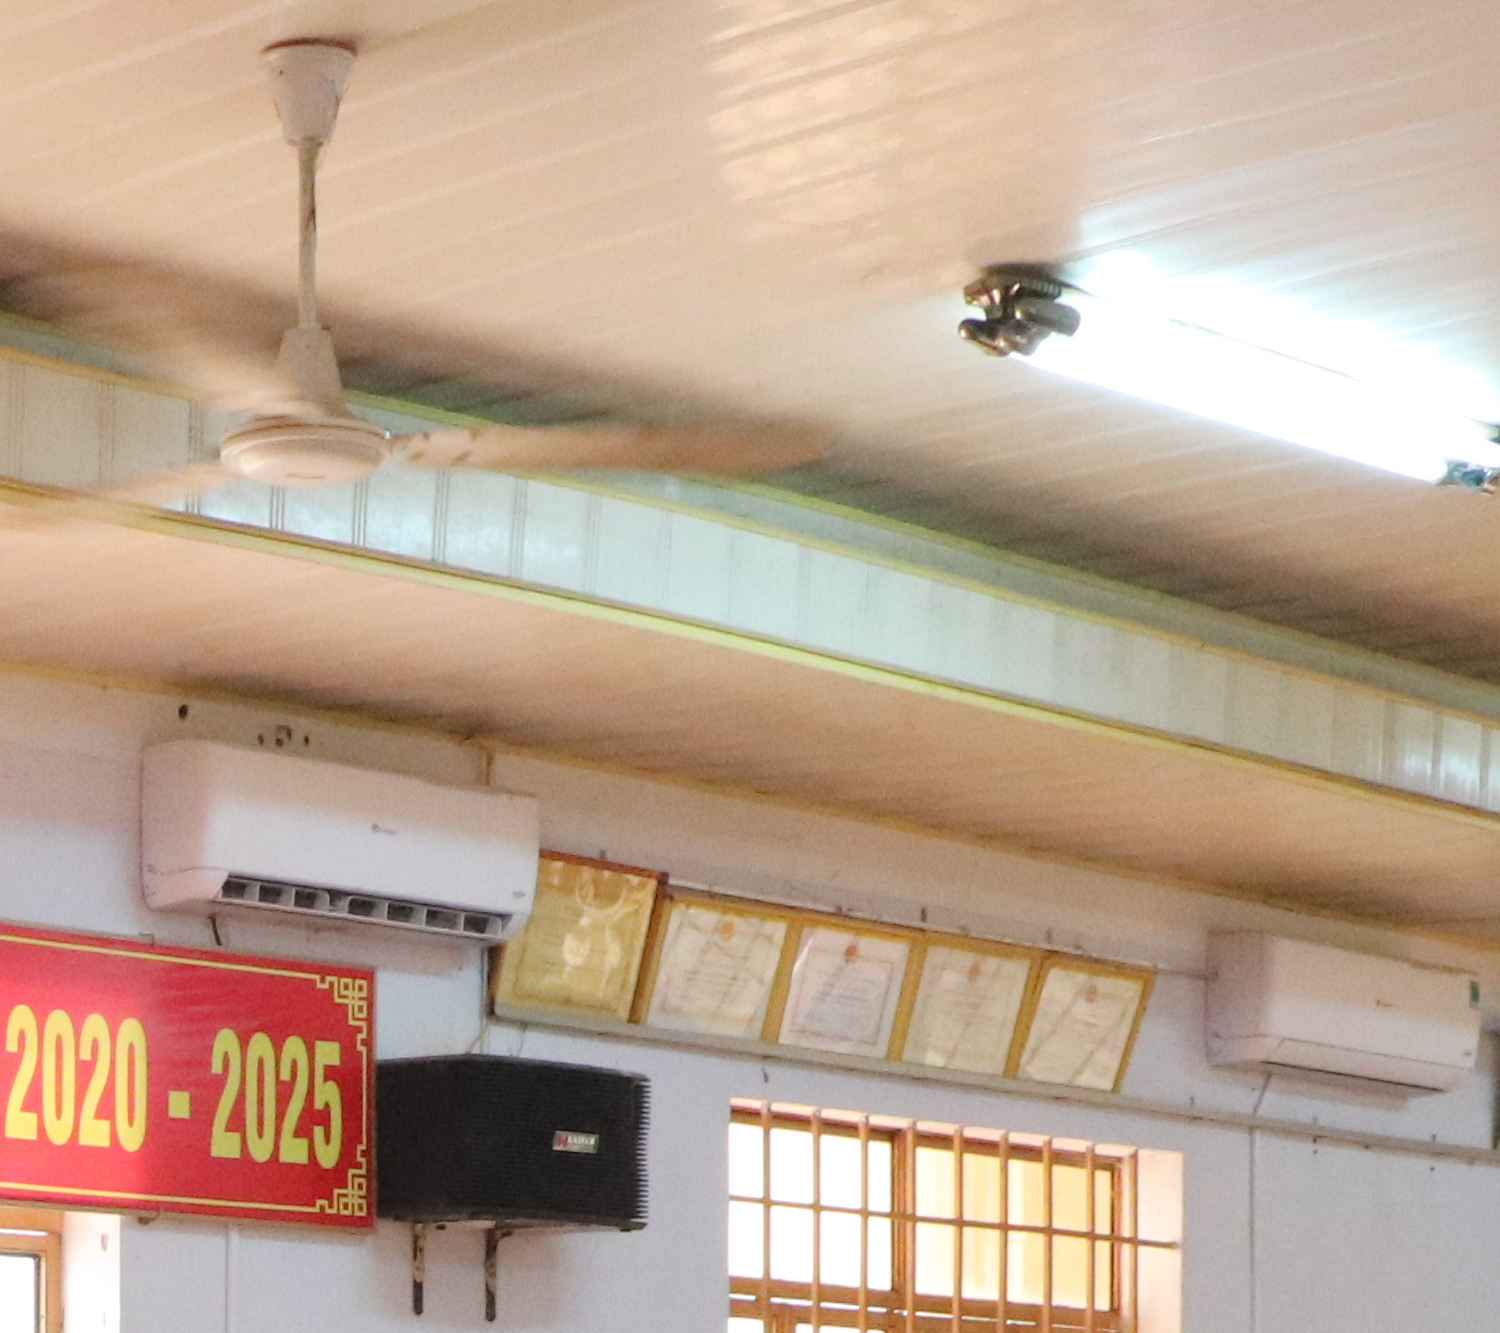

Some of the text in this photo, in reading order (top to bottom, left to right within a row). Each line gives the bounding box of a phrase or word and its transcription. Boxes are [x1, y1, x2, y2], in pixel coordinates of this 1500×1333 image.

[4, 1004, 148, 1152] 2020
[167, 1090, 191, 1119] -
[210, 1028, 344, 1169] 2025
